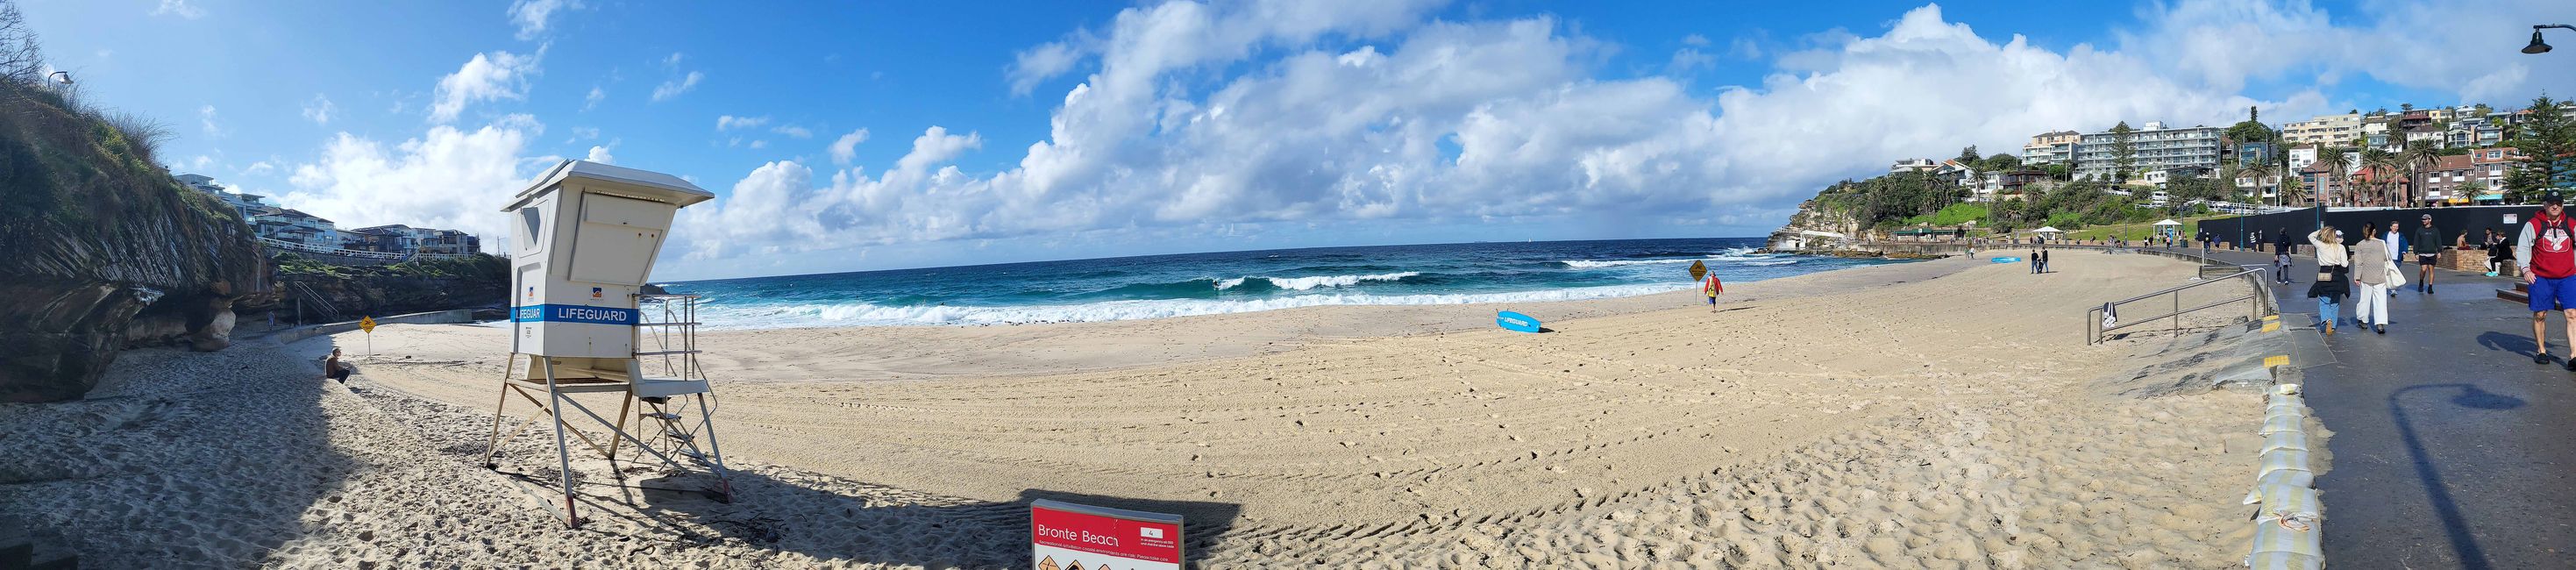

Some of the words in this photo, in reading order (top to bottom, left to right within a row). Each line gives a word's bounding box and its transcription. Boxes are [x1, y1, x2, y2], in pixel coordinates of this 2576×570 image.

[558, 308, 627, 322] LIFEGUARD
[1505, 317, 1528, 326] LIFEGUARD
[1039, 524, 1078, 541] Bronte
